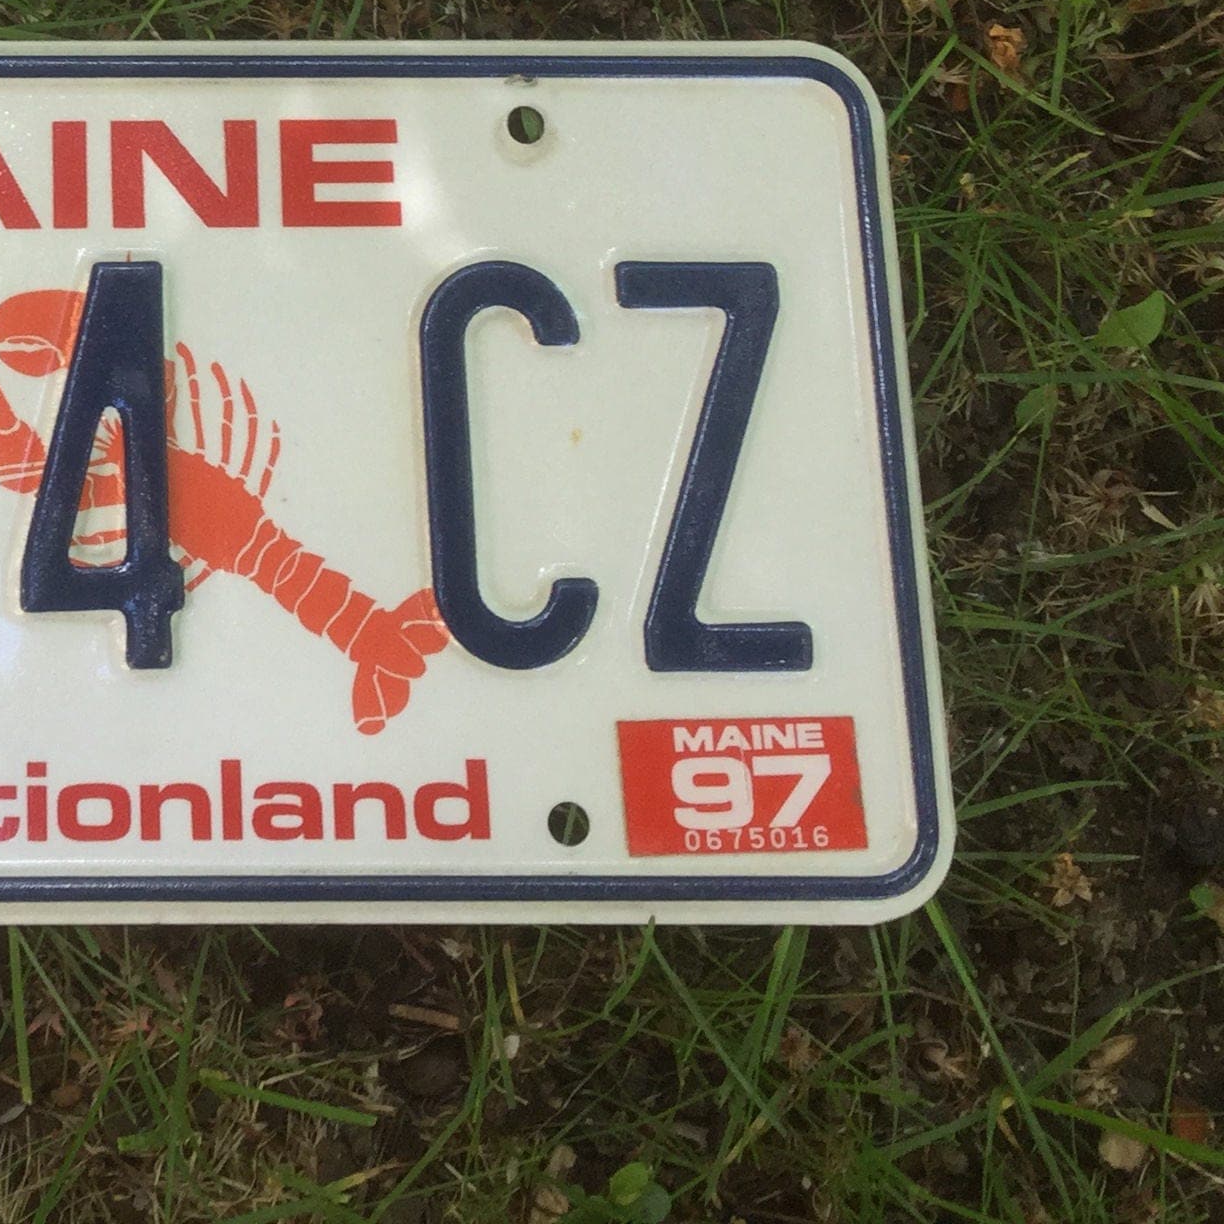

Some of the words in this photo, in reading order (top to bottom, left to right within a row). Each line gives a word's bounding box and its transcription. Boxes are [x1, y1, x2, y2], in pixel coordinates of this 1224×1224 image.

[417, 260, 816, 673] CZ
[672, 722, 825, 753] MAINE
[671, 753, 832, 831] 97
[684, 825, 830, 852] 0675016
